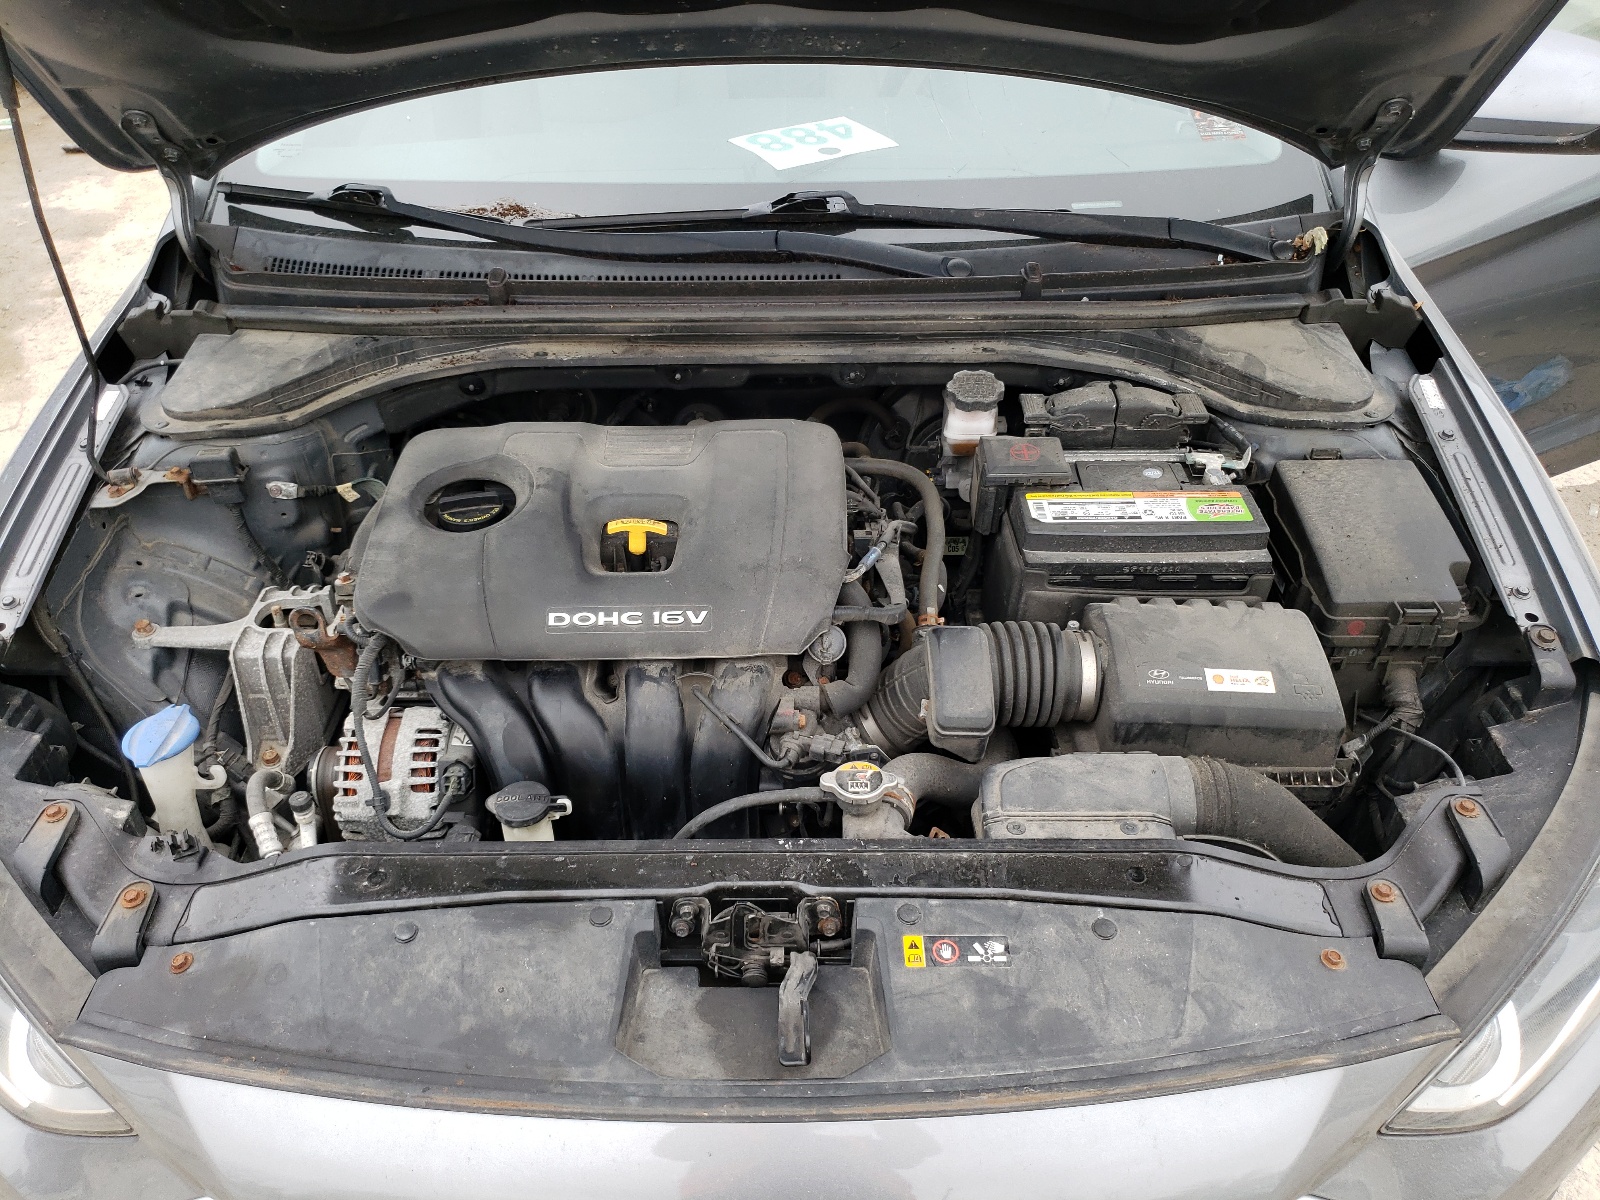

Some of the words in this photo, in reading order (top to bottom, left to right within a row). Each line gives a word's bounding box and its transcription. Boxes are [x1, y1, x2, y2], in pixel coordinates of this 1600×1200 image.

[746, 123, 853, 151] 488
[548, 611, 644, 626] DOHC
[653, 610, 709, 625] 16V
[496, 794, 550, 803] COOLANT
